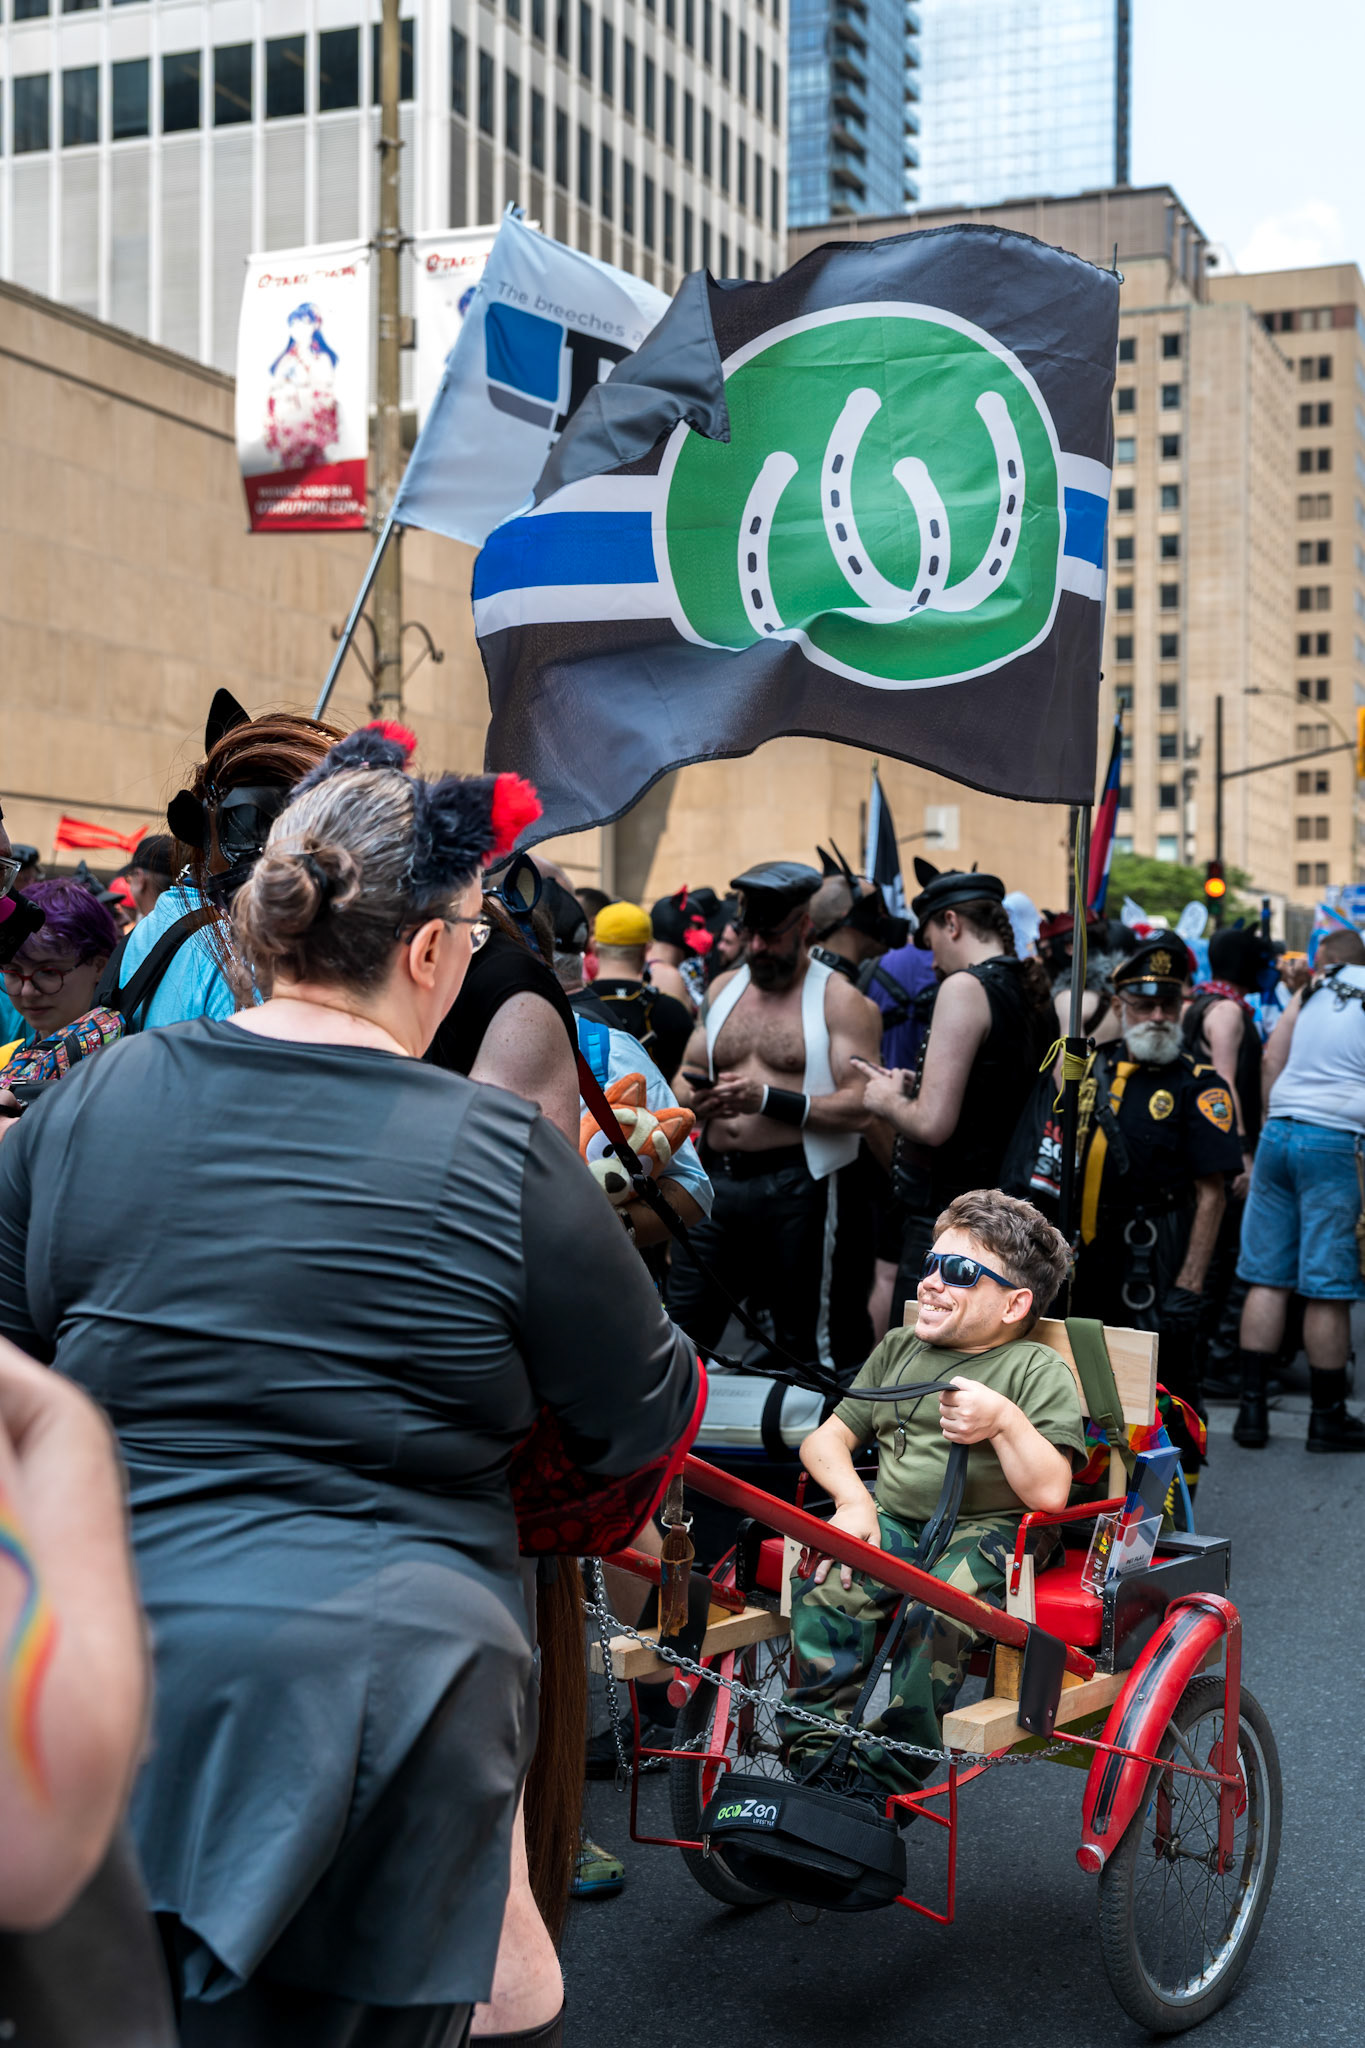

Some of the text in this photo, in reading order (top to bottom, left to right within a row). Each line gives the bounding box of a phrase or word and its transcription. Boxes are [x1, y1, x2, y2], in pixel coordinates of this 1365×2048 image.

[498, 281, 529, 305] The
[534, 295, 626, 338] breeches
[717, 1799, 777, 1820] ecoZen
[752, 1818, 775, 1826] LIFESTYLE
